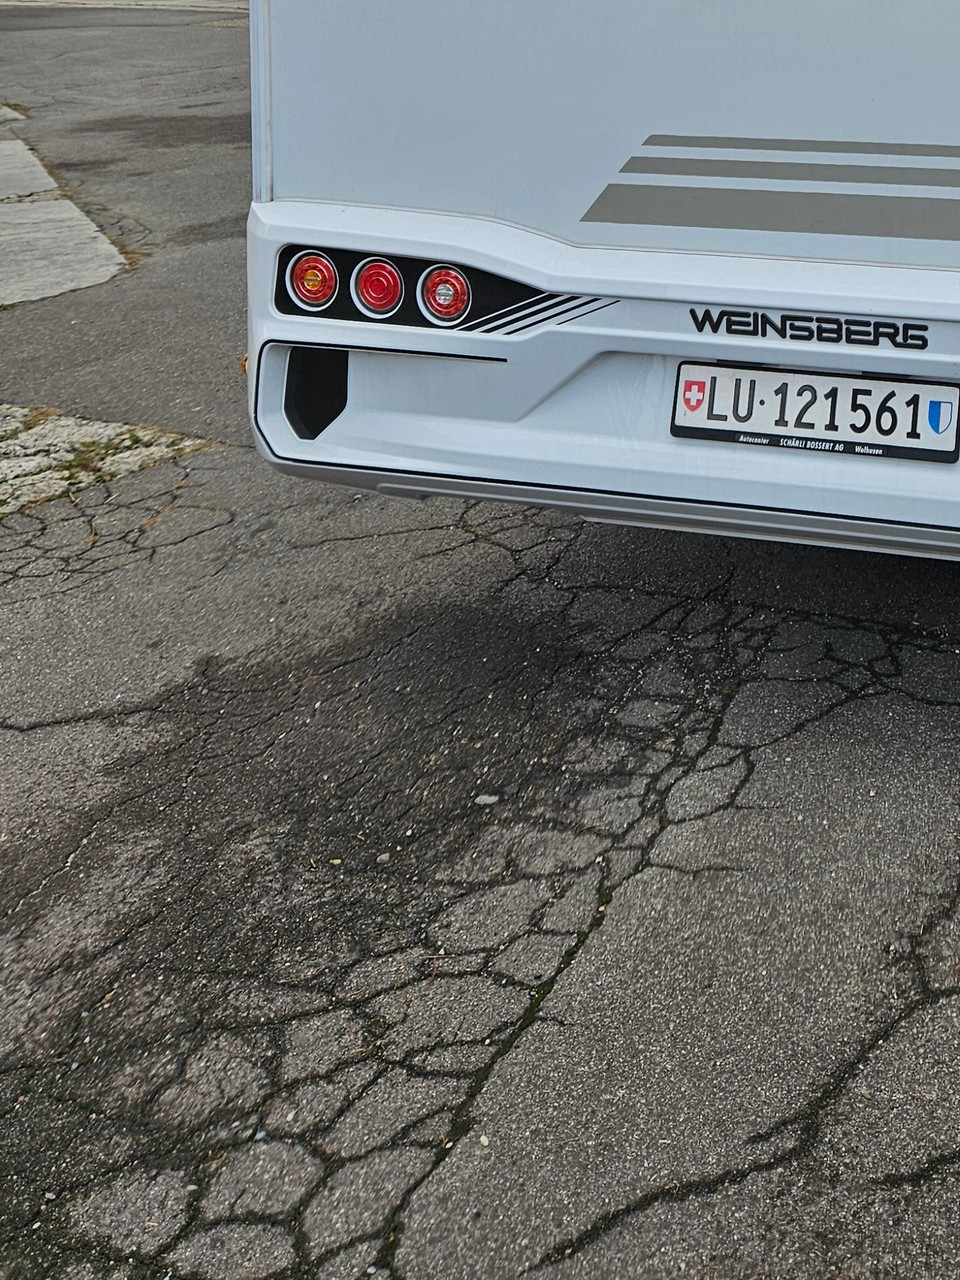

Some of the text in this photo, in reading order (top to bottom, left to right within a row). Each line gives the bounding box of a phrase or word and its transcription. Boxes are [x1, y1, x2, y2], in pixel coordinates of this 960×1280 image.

[690, 308, 929, 350] WEINSBERG
[739, 435, 883, 455] Autocenter SCHÄRLI BOSSERT AG Wolhusen
